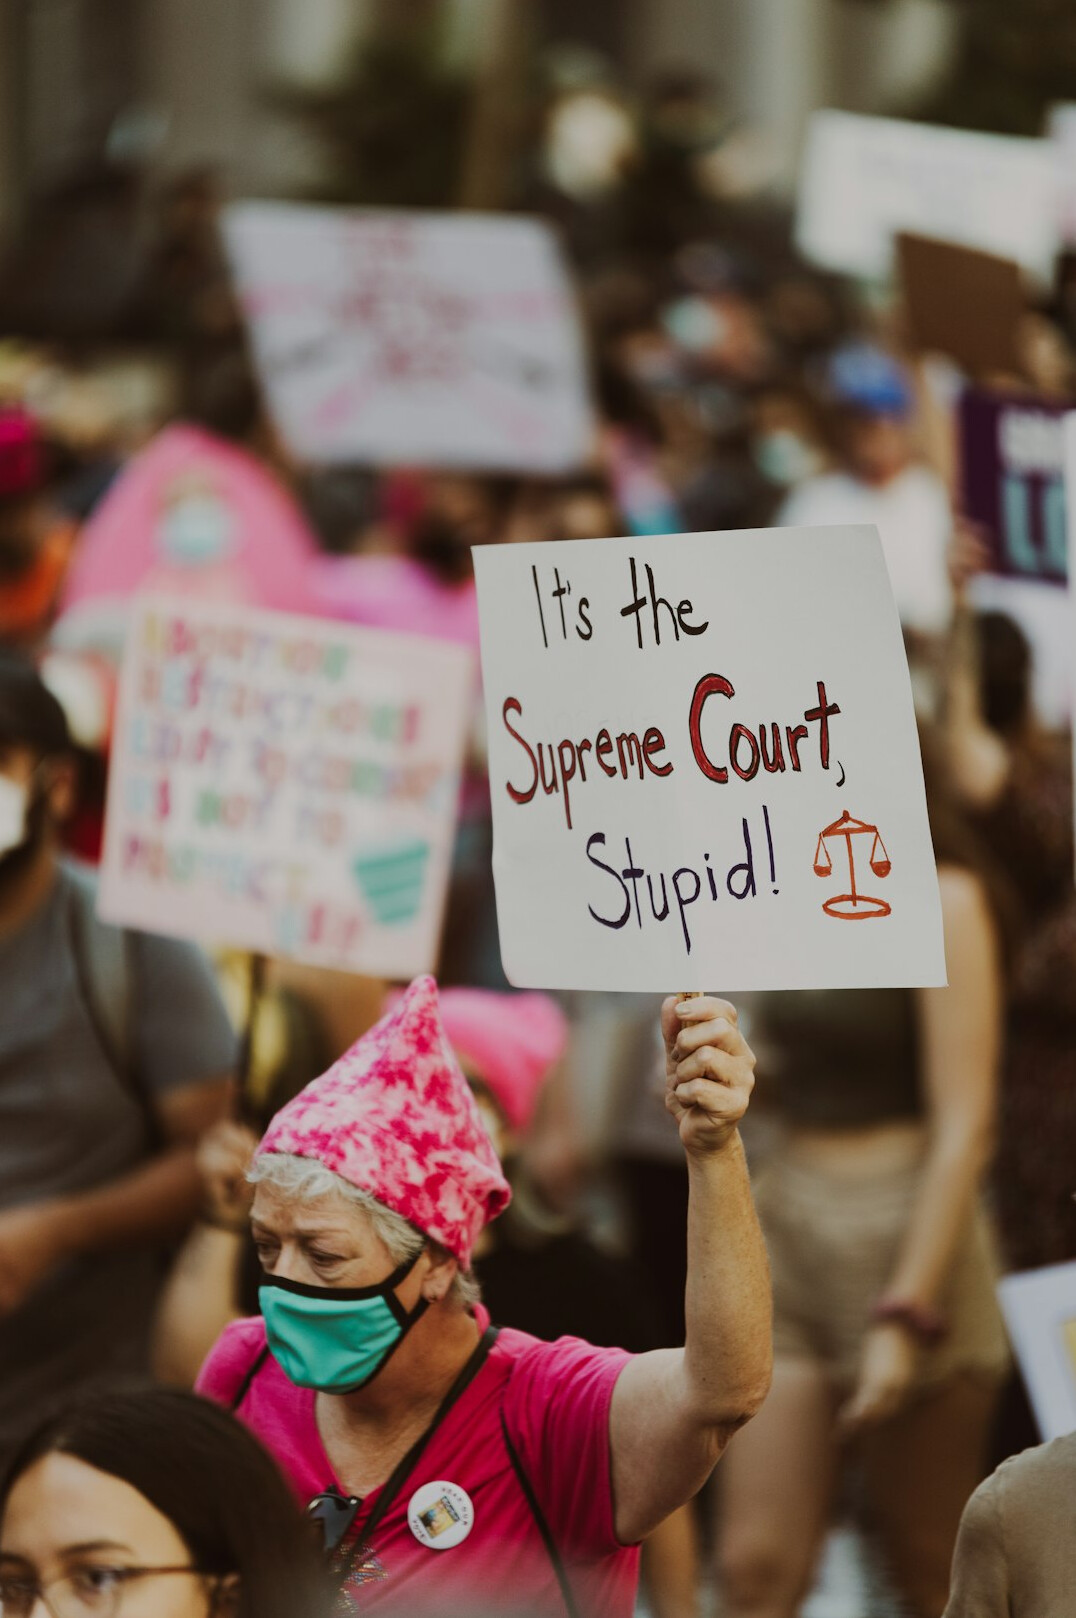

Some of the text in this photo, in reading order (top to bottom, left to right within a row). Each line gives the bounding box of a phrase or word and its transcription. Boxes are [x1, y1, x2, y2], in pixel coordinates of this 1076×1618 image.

[532, 557, 709, 649] It's the
[503, 673, 845, 830] Supreme Court,
[586, 805, 779, 955] Stupid!
